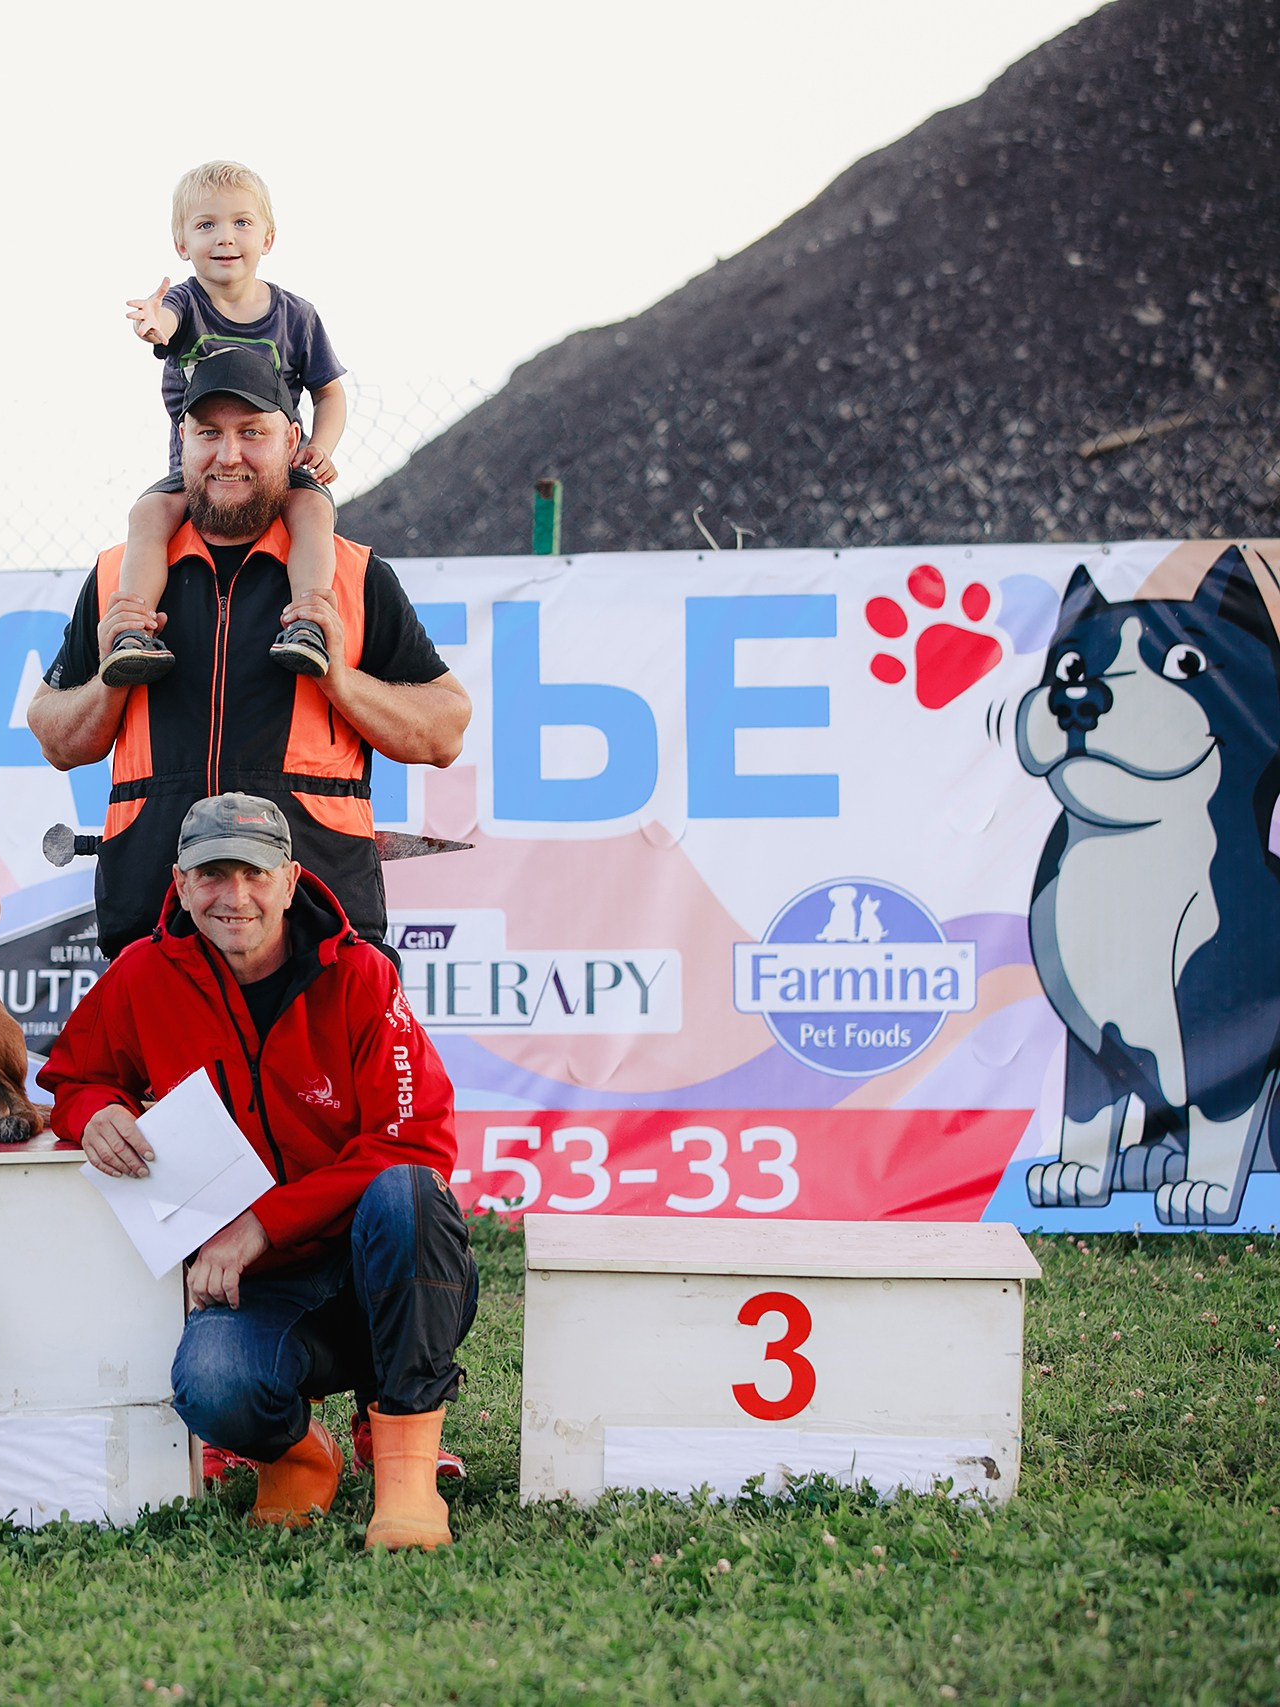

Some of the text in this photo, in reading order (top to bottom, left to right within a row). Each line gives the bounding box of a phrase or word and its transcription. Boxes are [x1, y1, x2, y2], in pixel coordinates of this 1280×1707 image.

[50, 945, 91, 962] ULTRA
[751, 952, 960, 1002] Farmina
[399, 959, 667, 1018] HERAPY
[21, 1021, 61, 1036] ATURAL
[800, 1022, 912, 1048] Pet Foods
[387, 1045, 414, 1138] DECH.EU
[730, 1290, 817, 1422] 3
